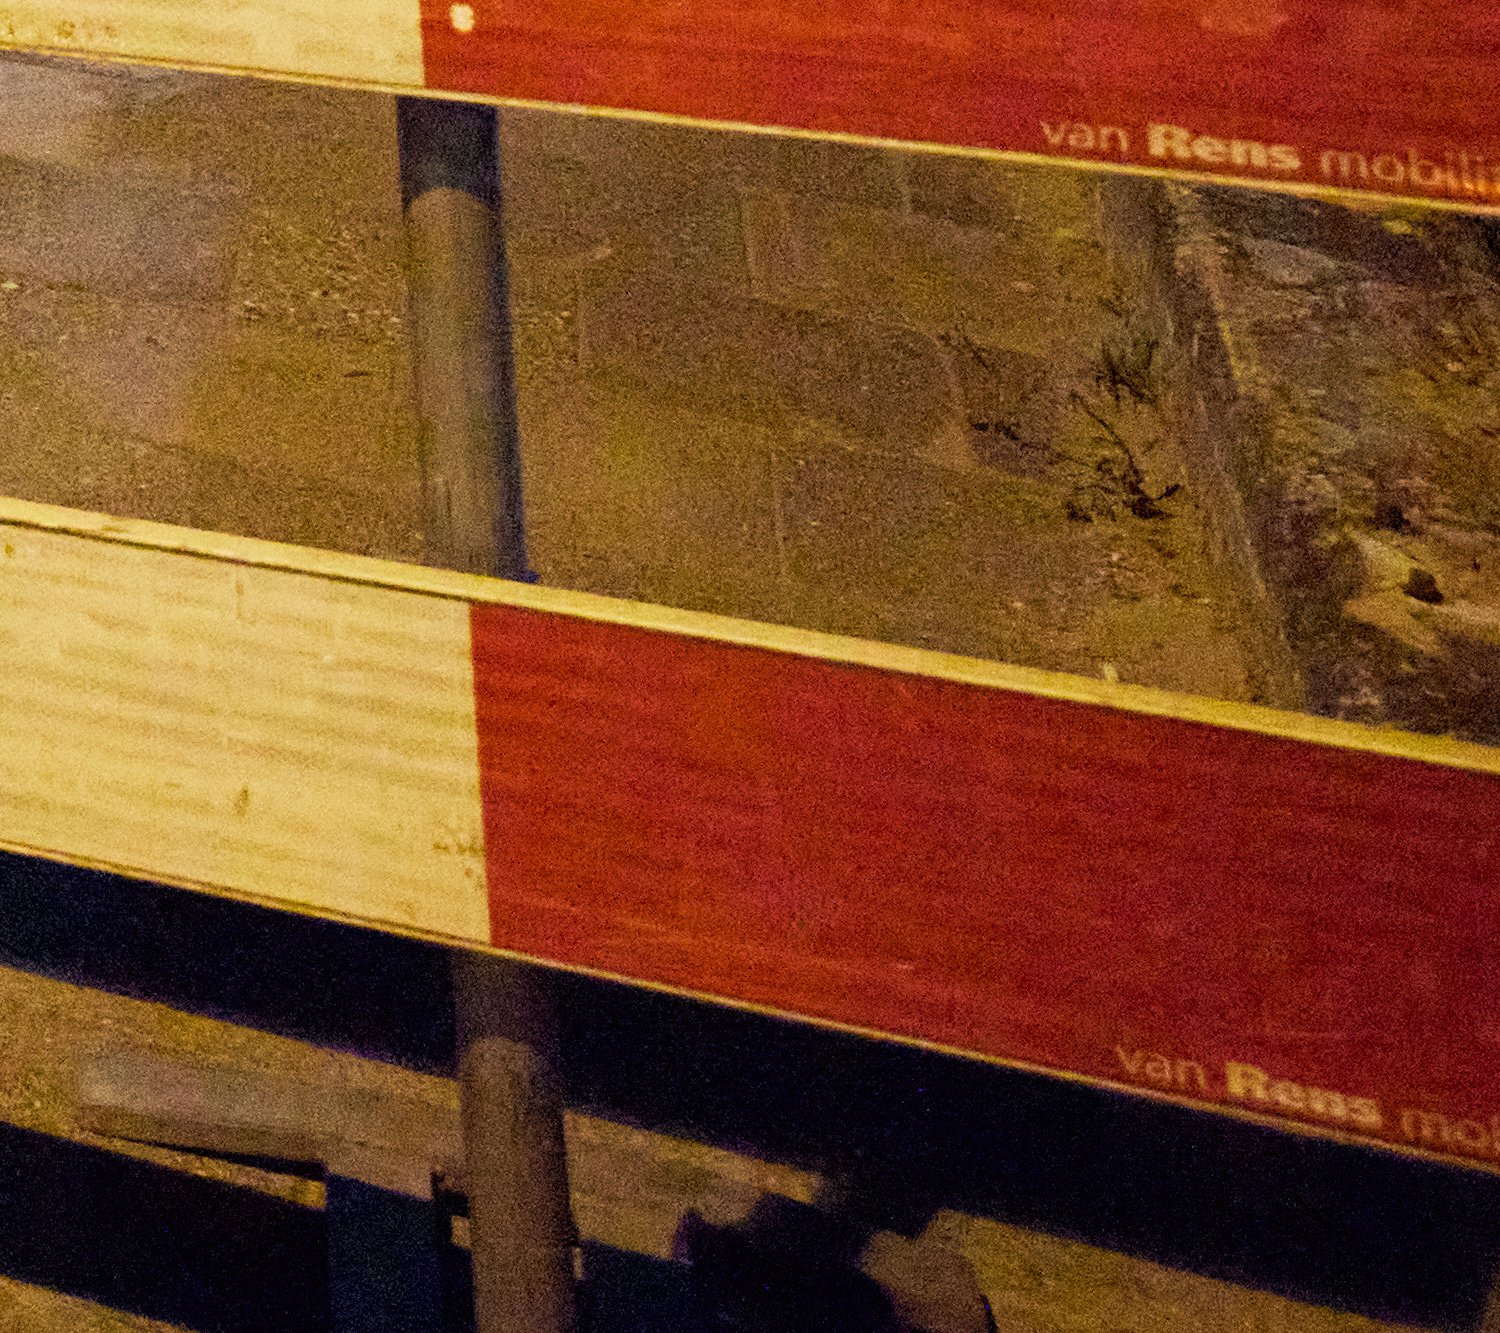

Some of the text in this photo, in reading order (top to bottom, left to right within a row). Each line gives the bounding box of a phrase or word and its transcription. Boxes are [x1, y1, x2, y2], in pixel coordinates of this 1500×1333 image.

[1039, 120, 1129, 153] van
[1147, 122, 1301, 170] Rens
[1115, 1044, 1500, 1155] van Rens mo
